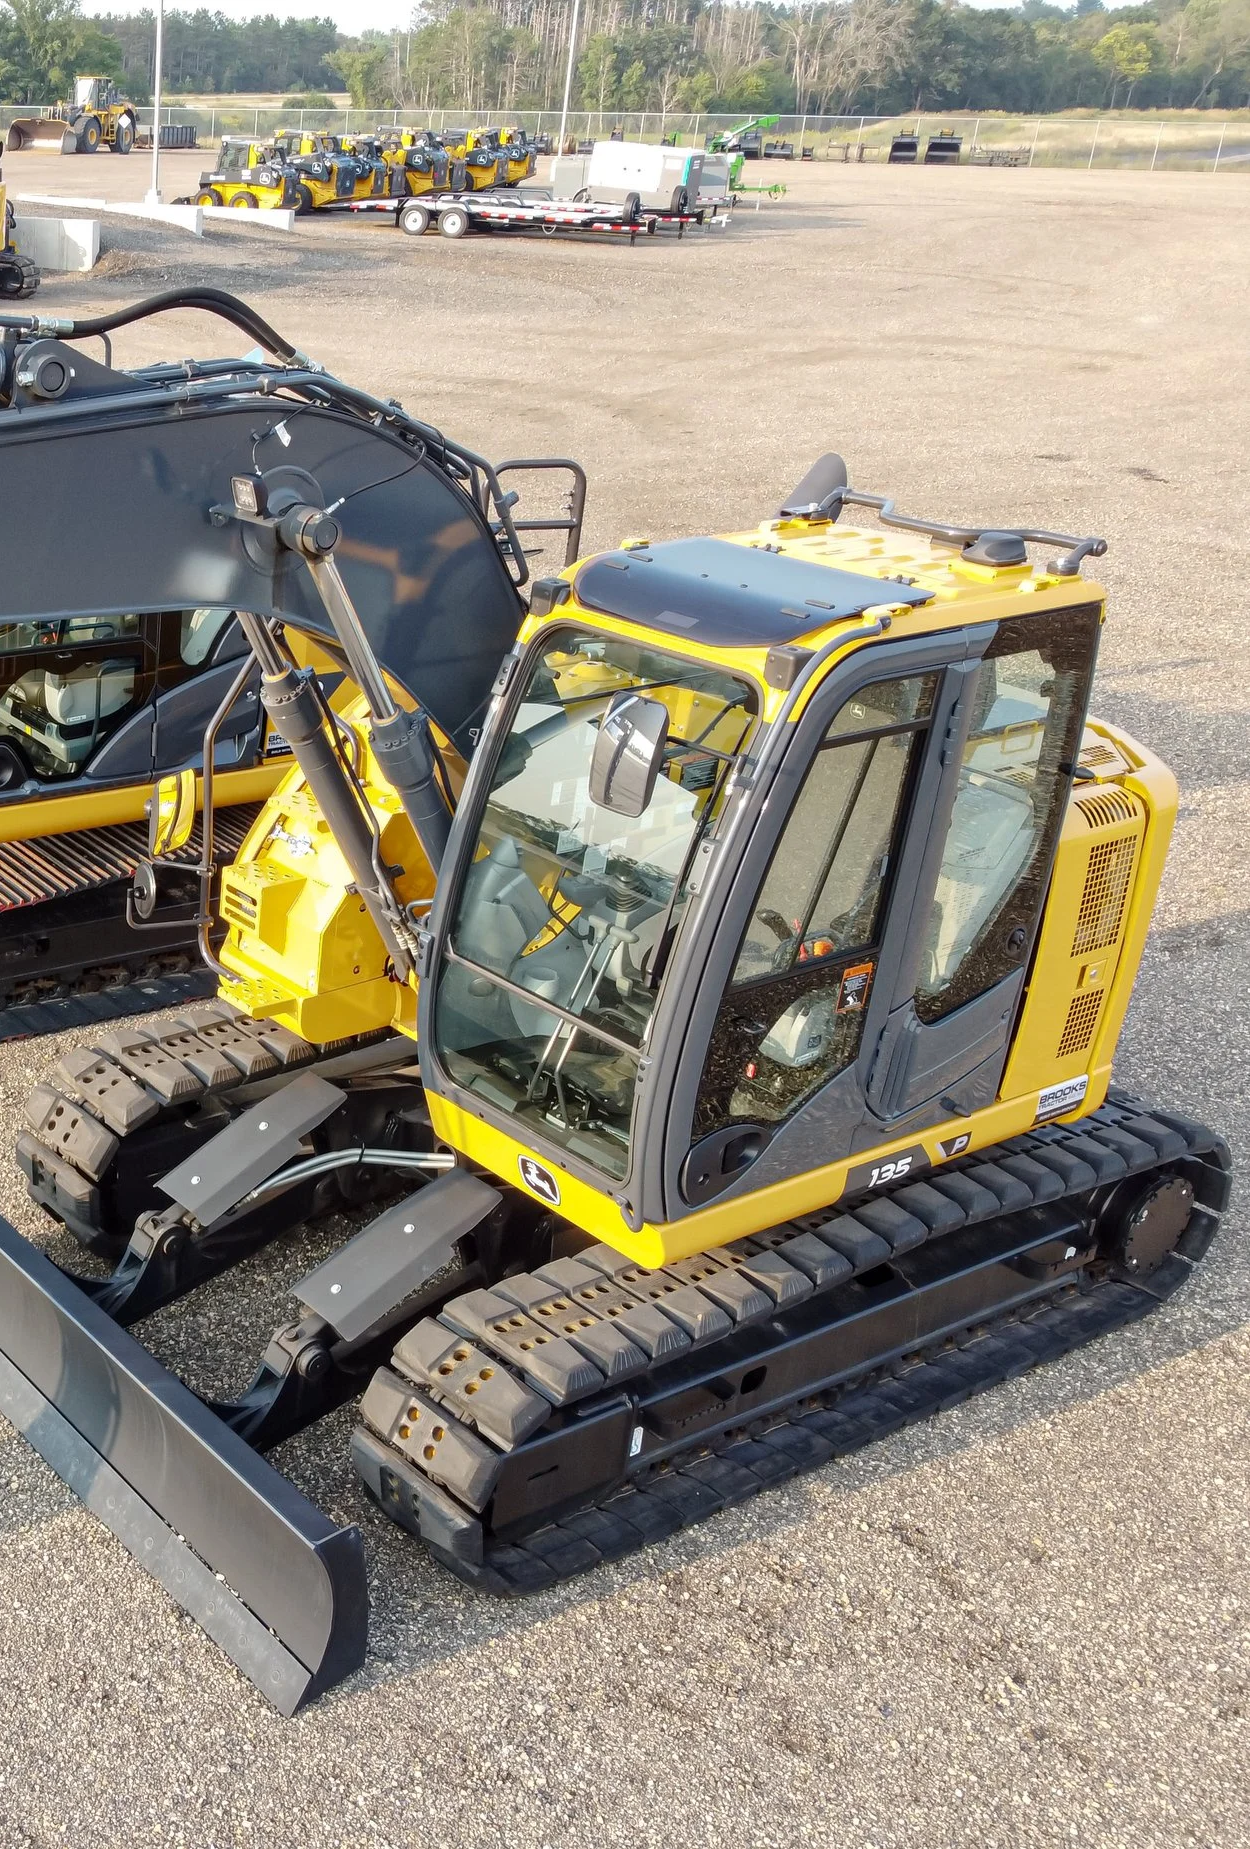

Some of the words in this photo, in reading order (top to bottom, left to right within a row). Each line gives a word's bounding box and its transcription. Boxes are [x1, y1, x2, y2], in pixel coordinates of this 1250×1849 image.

[1038, 1097, 1068, 1110] TRACTOR
[1039, 1081, 1087, 1104] BROOKS
[868, 1156, 912, 1188] 135
[950, 1135, 969, 1155] P
